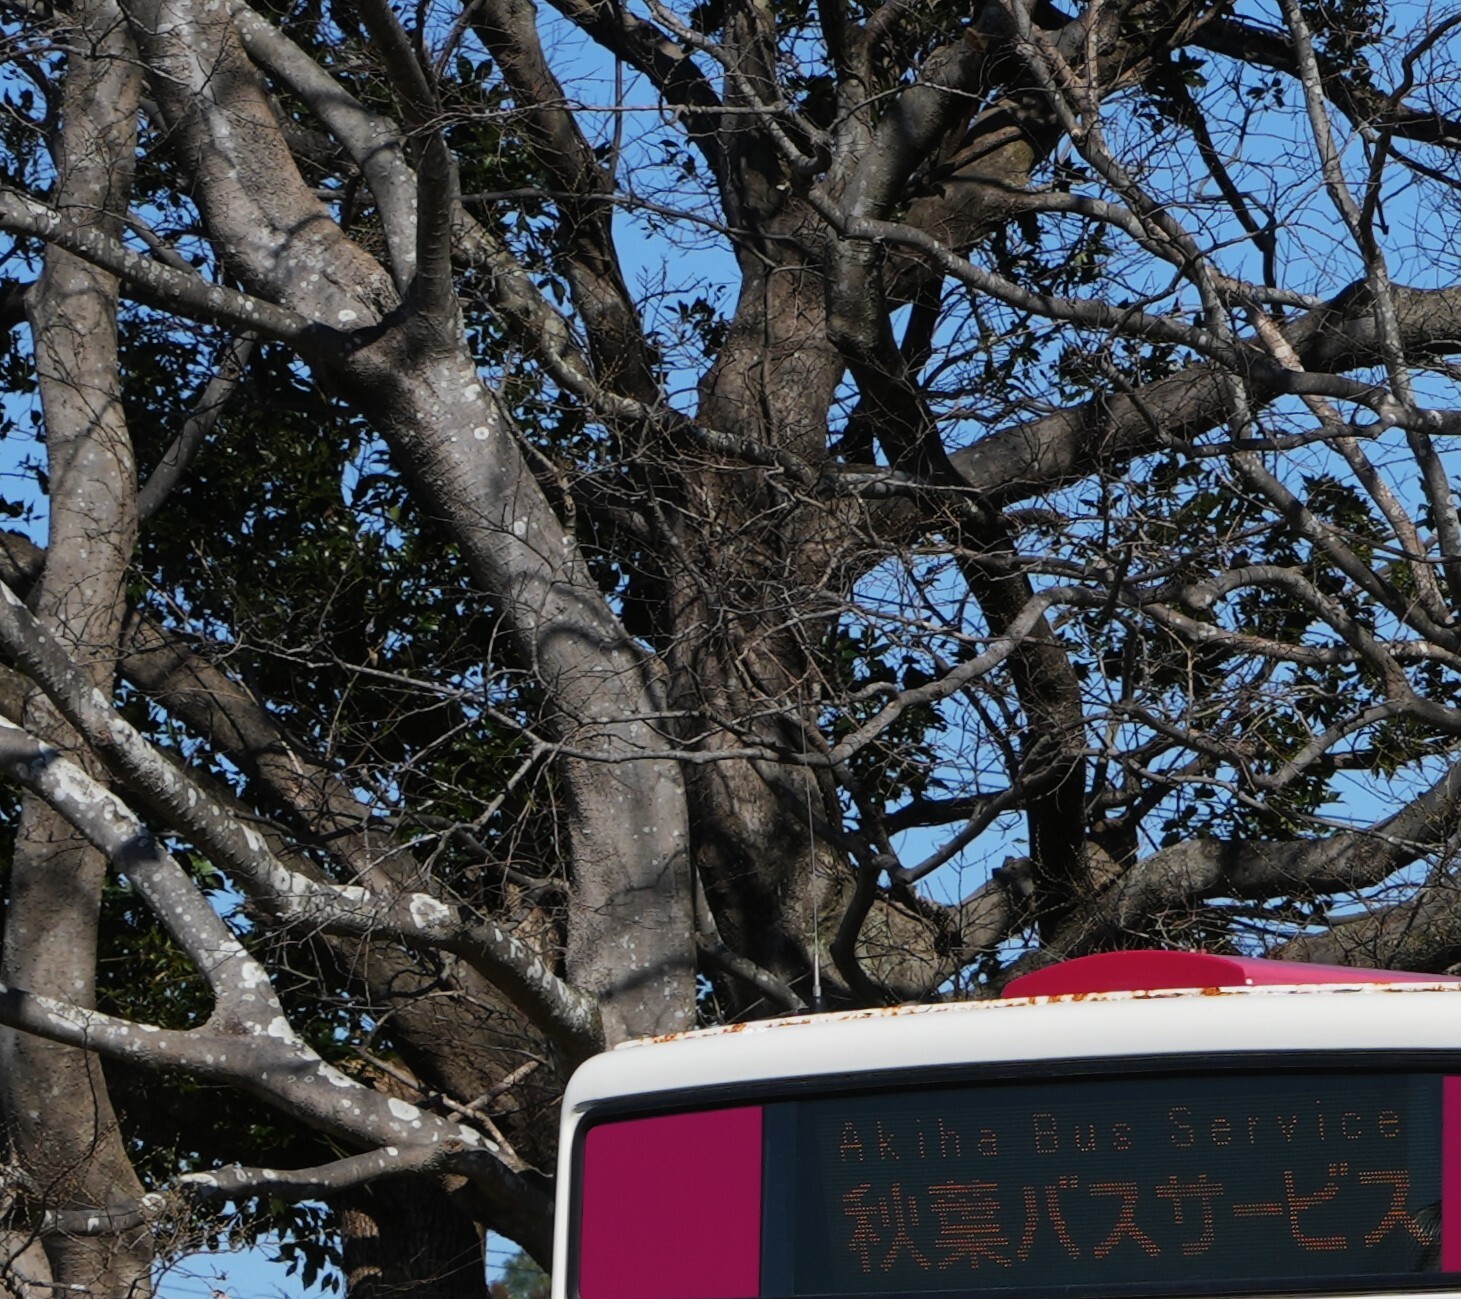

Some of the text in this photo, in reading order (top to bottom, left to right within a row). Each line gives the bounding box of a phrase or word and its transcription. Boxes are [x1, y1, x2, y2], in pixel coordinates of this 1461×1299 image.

[839, 1100, 1401, 1162] Akiha Bus Service
[841, 1162, 1433, 1273] 秋葉バスサービス
